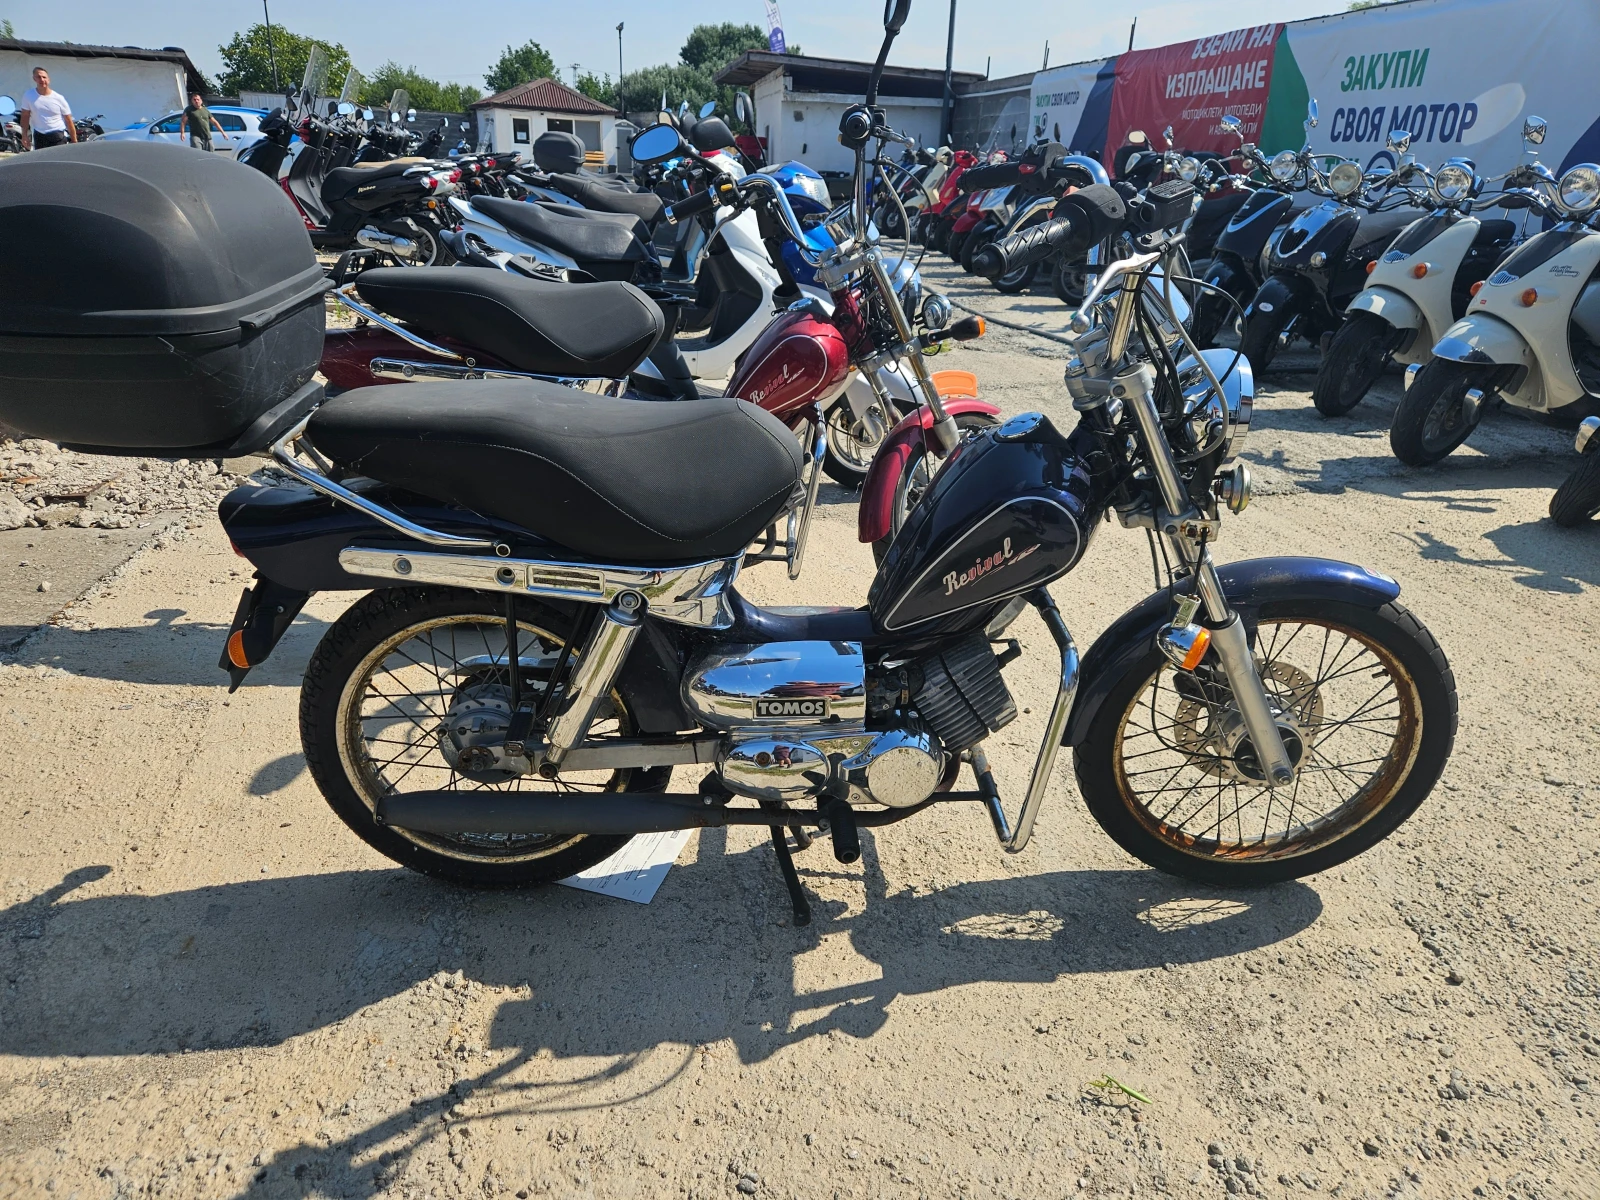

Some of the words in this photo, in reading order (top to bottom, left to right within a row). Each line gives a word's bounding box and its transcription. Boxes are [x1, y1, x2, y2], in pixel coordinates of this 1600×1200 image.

[1191, 29, 1249, 60] ВЗЕМИ
[1246, 23, 1277, 49] НА
[1165, 60, 1268, 99] ИЗПЛАЩАНЕ
[1340, 48, 1430, 92] ЗАКУПИ
[1330, 106, 1386, 143] СВОЯ
[1386, 102, 1478, 143] МОТОР
[750, 363, 790, 405] Revival
[943, 537, 1014, 596] Revival
[758, 701, 824, 715] TOMOS
